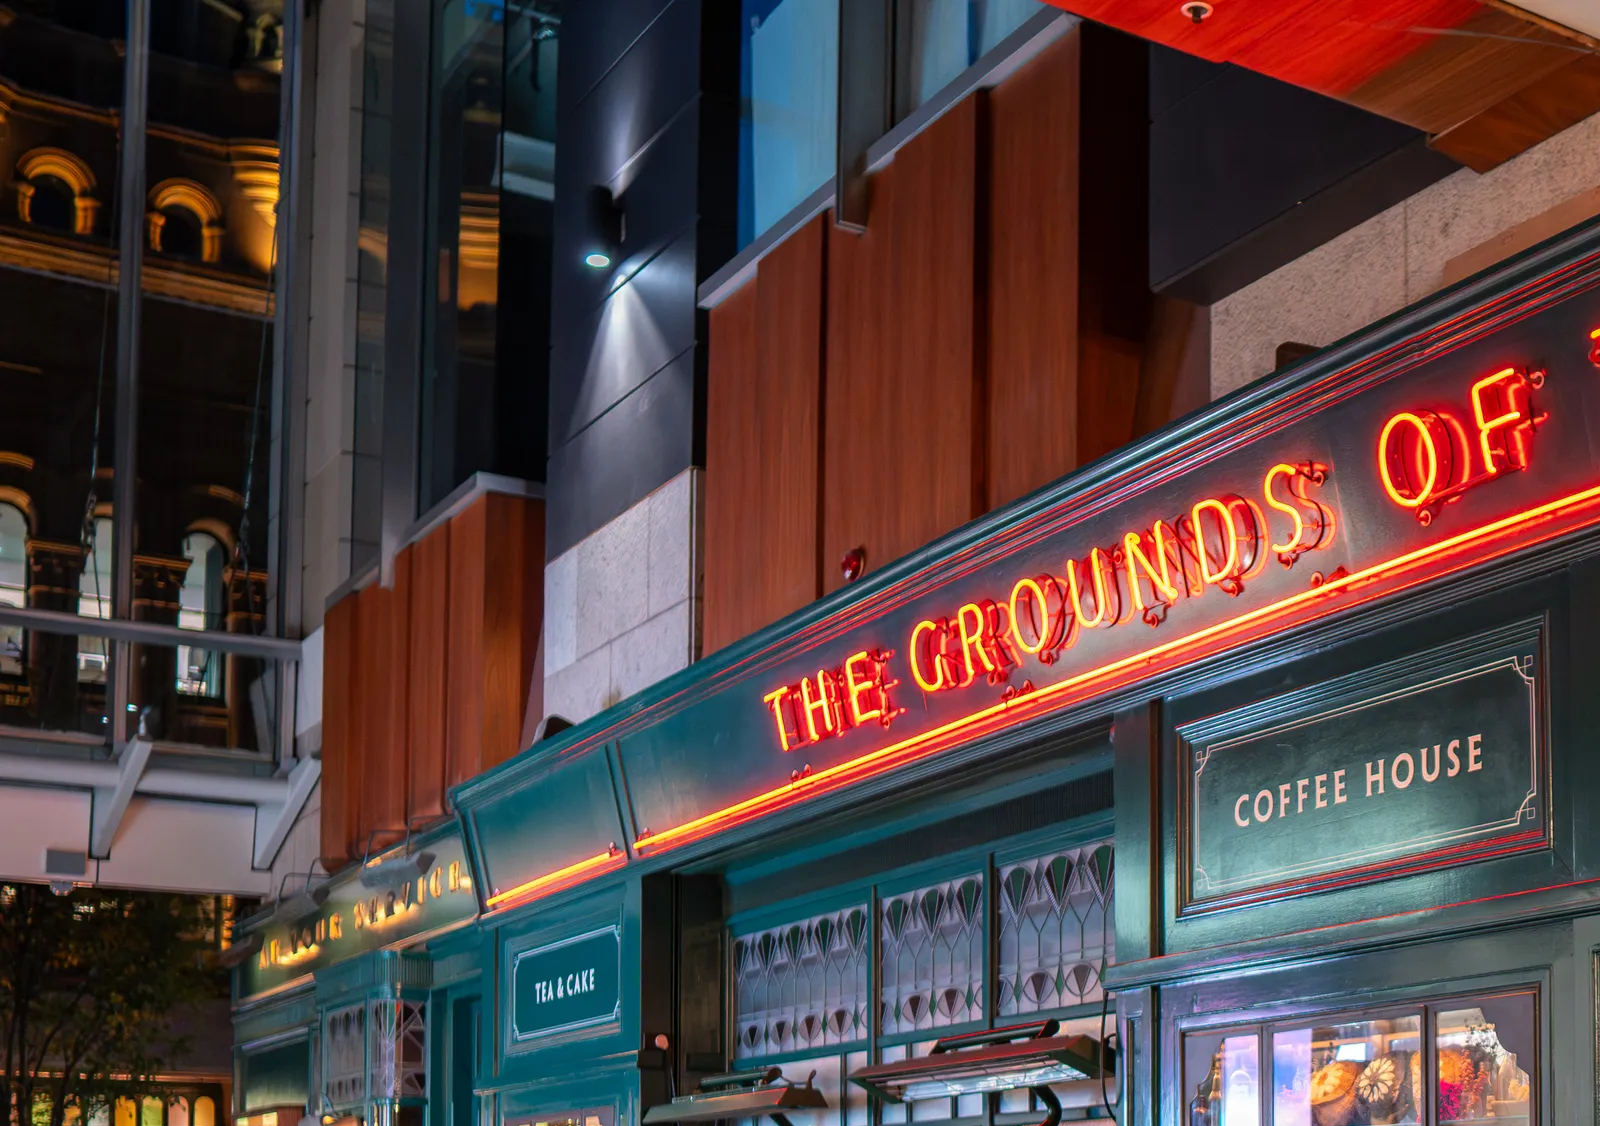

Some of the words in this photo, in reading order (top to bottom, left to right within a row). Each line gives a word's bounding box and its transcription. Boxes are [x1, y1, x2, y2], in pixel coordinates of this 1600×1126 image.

[763, 651, 893, 752] THE
[909, 462, 1318, 692] GROUNDS
[1379, 369, 1521, 506] OF
[1234, 769, 1348, 827] COFFEE
[1365, 734, 1483, 797] HOUSE
[535, 979, 554, 1004] TEA
[556, 976, 564, 999] &
[566, 967, 595, 997] CAKE
